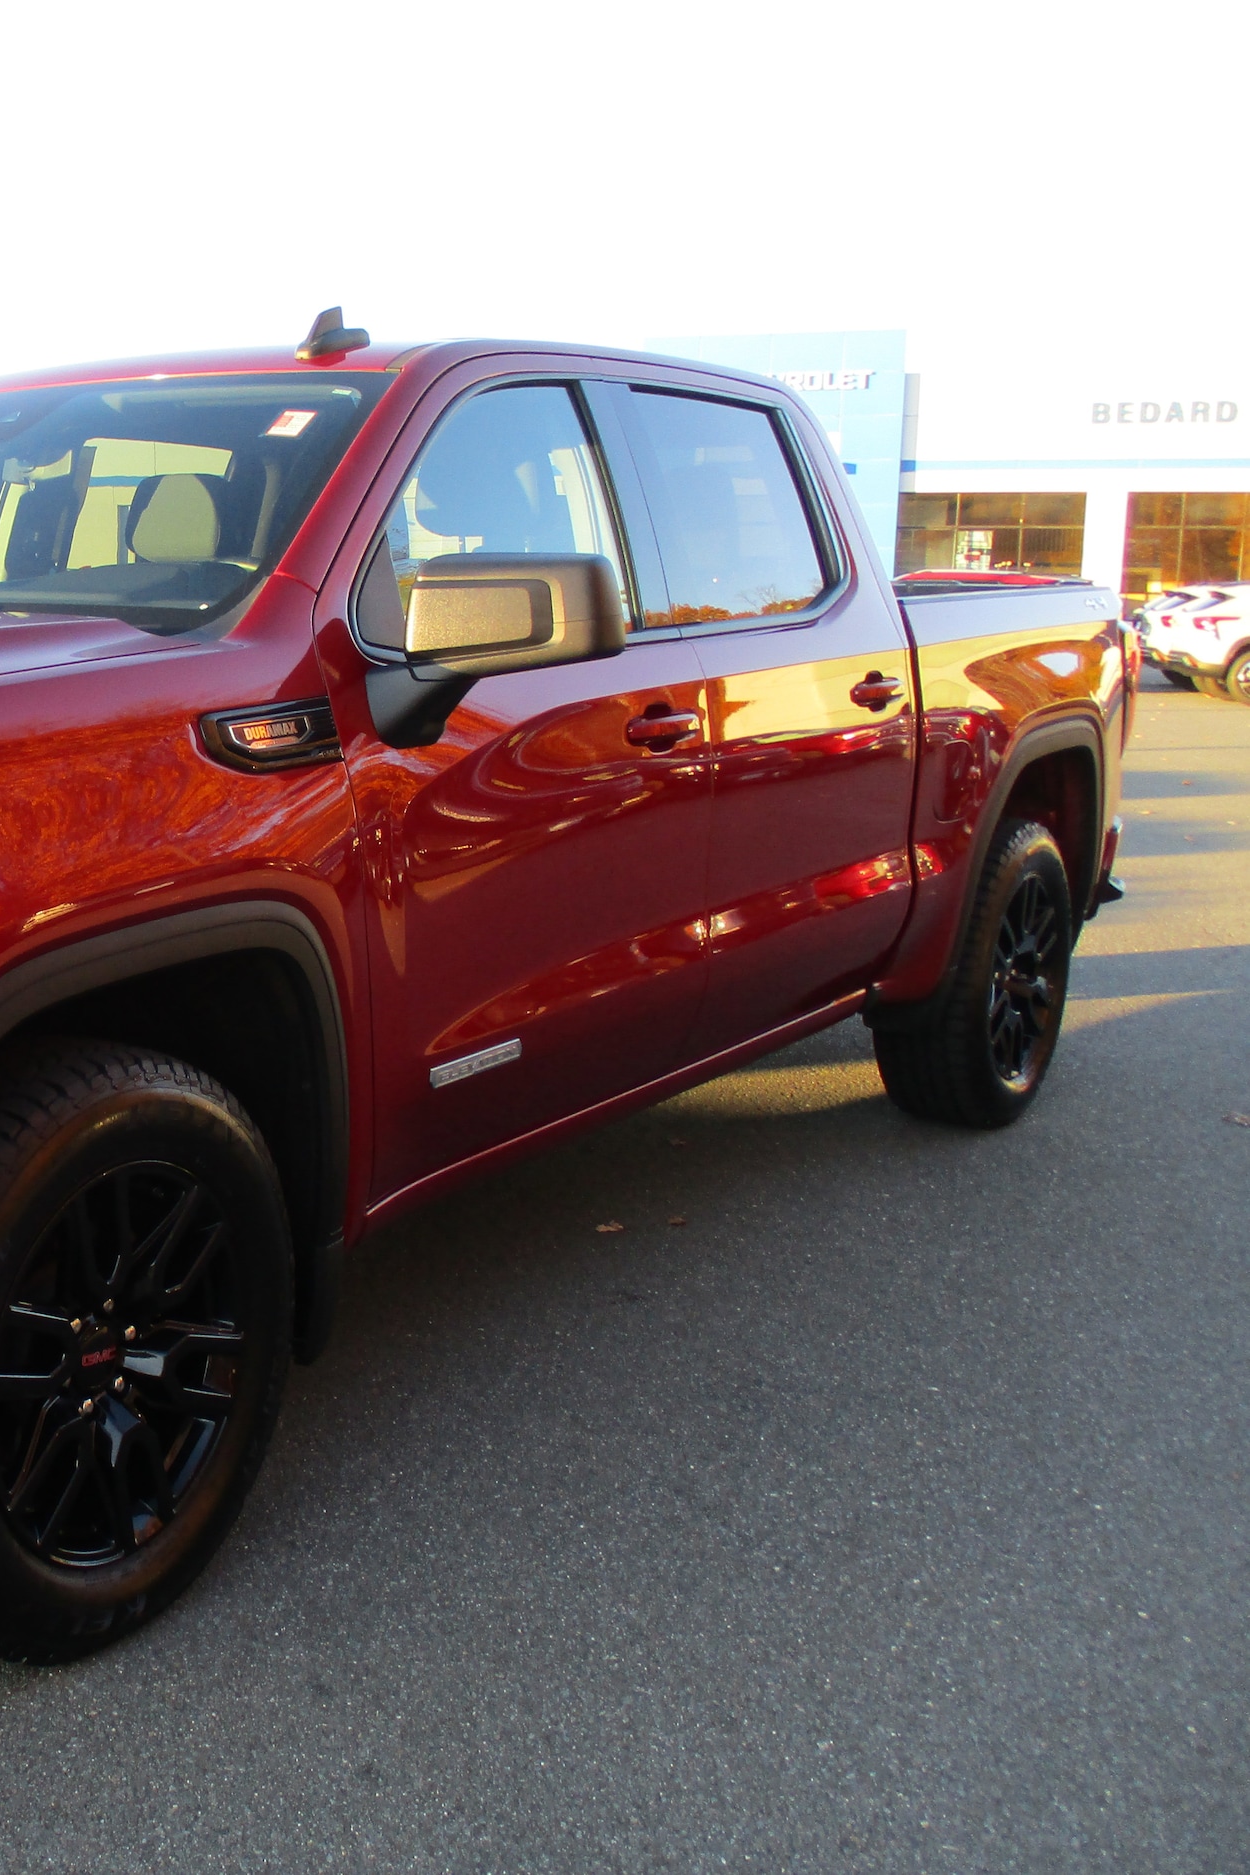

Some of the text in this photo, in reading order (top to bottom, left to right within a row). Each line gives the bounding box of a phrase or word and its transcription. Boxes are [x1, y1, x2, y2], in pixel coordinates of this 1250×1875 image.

[762, 369, 877, 391] ROLET
[1091, 400, 1239, 424] BEDARD
[243, 721, 298, 741] DURAMAX
[81, 1345, 117, 1367] GMC
